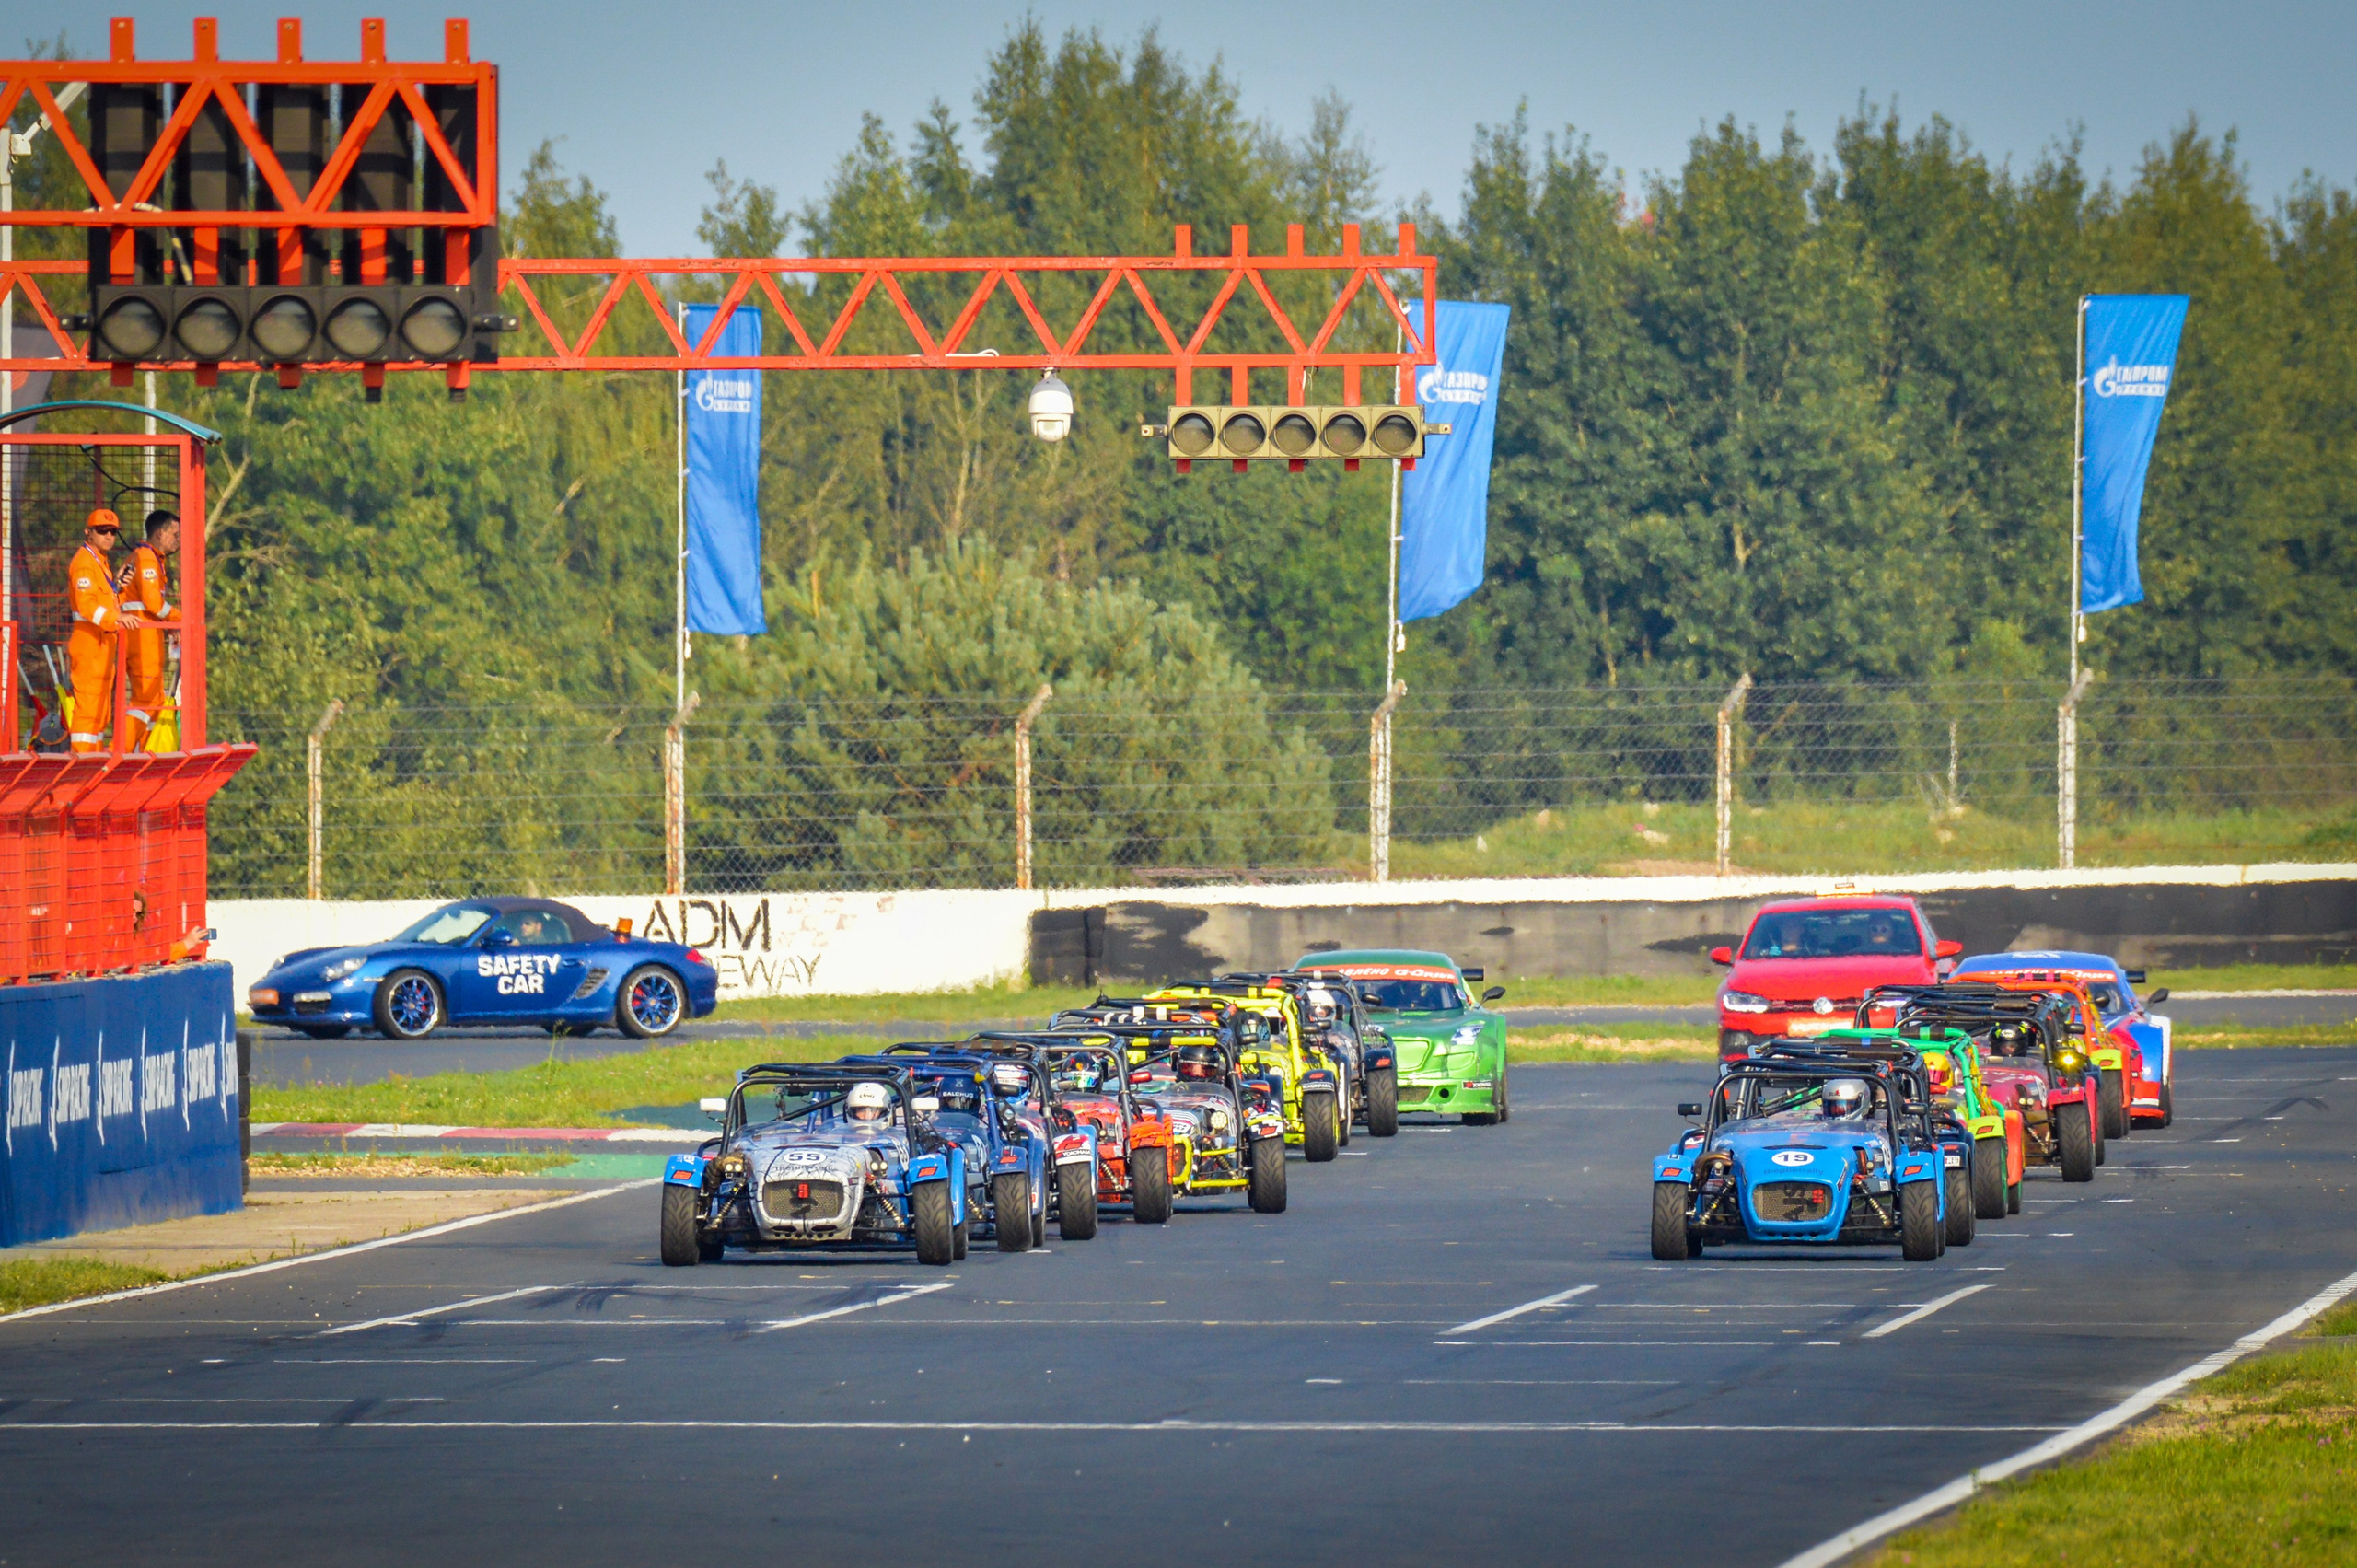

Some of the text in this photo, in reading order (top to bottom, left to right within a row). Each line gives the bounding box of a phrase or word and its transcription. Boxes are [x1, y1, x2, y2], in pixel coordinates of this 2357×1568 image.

[643, 898, 772, 952] ADM
[478, 953, 562, 976] SAFETY
[711, 953, 821, 993] EWAY
[497, 973, 545, 994] CAR
[788, 1152, 821, 1161] 55
[1778, 1154, 1808, 1162] 19
